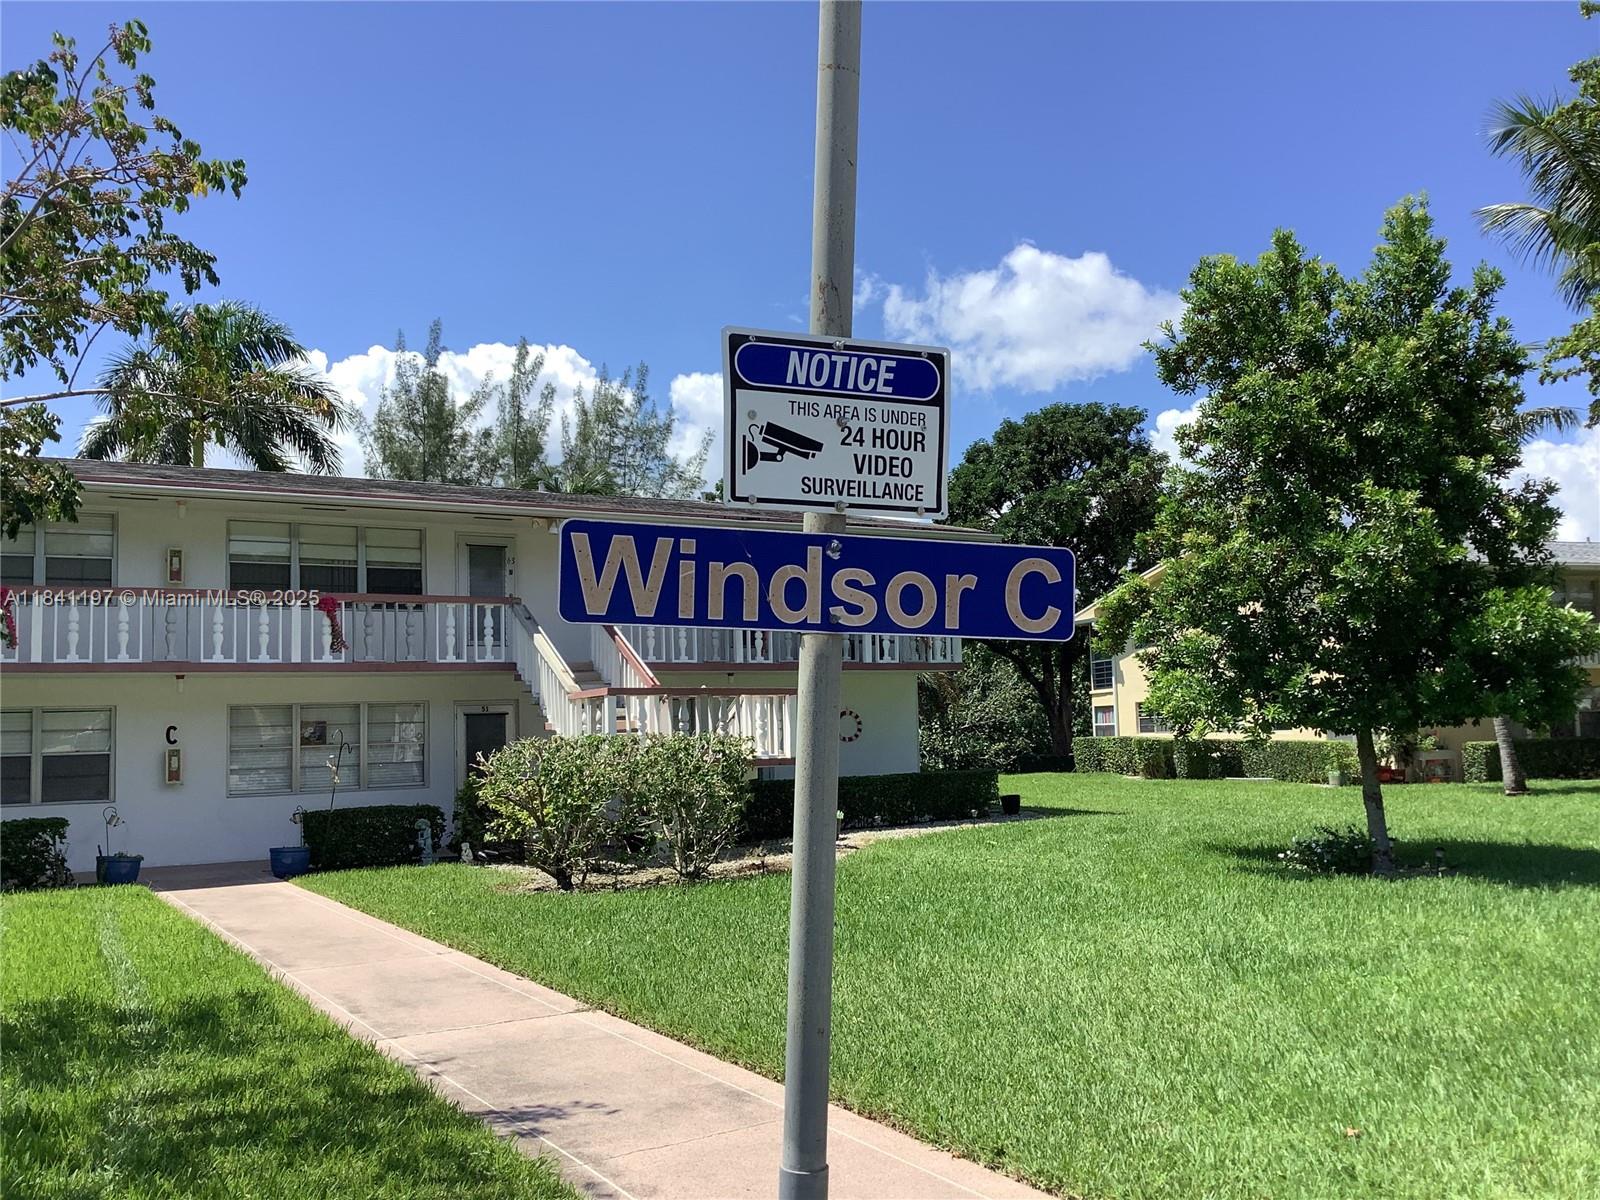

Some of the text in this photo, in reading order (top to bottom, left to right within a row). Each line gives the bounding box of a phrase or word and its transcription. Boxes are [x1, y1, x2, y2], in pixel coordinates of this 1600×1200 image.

[785, 350, 897, 393] NOTICE
[788, 400, 926, 427] THIS AREA IS UNDER
[840, 426, 926, 452] 24 HOUR
[853, 453, 913, 478] VIDEO
[801, 476, 924, 502] SURVEILLANCE
[570, 532, 1062, 633] Windsor C
[165, 725, 178, 745] C
